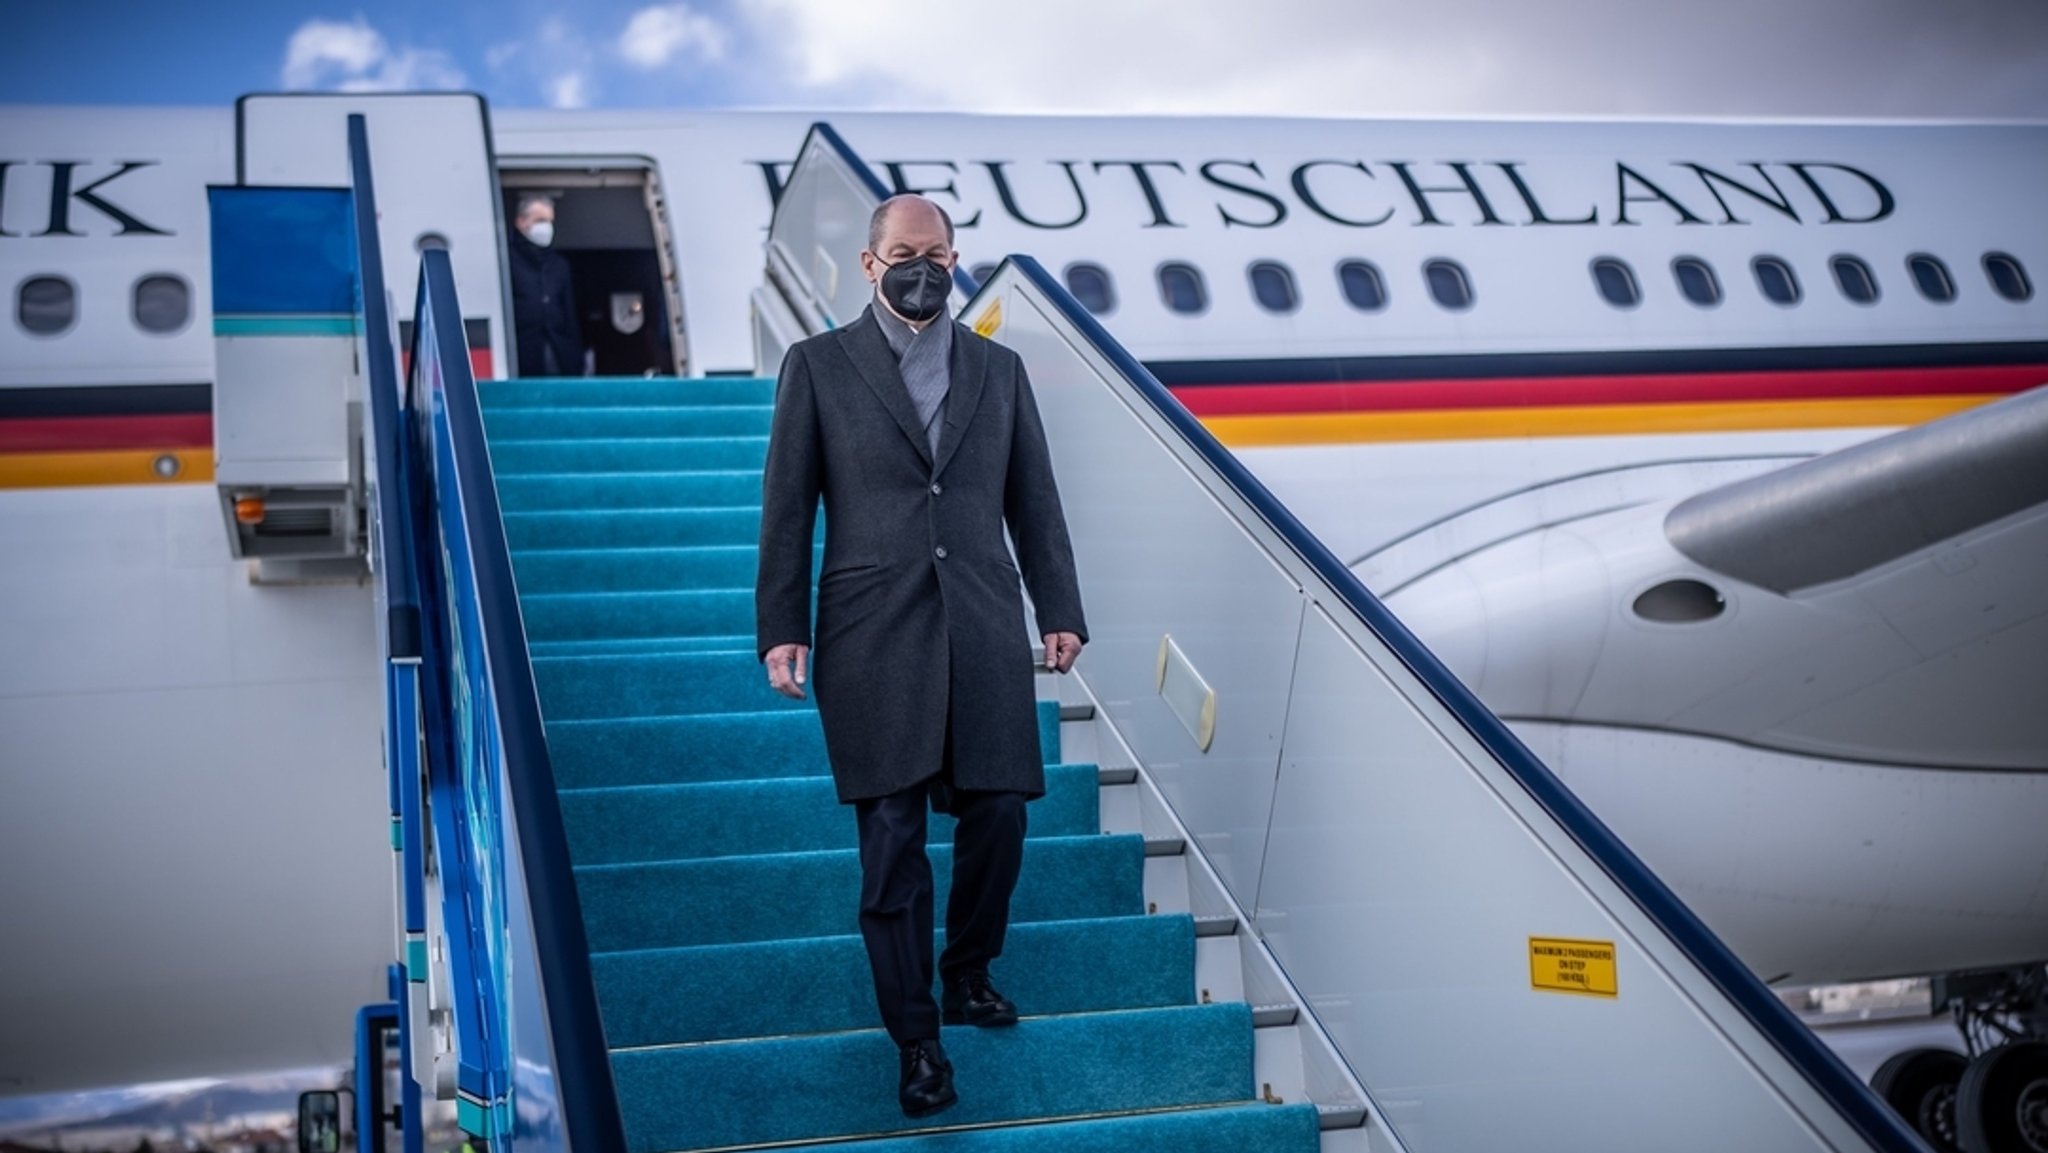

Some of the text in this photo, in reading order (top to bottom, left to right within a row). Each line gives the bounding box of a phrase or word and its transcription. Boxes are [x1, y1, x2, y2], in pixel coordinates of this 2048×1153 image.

[1534, 946, 1562, 956] MAXIMUM
[1569, 948, 1611, 960] PASSENGERS
[1559, 959, 1586, 971] ON STEP
